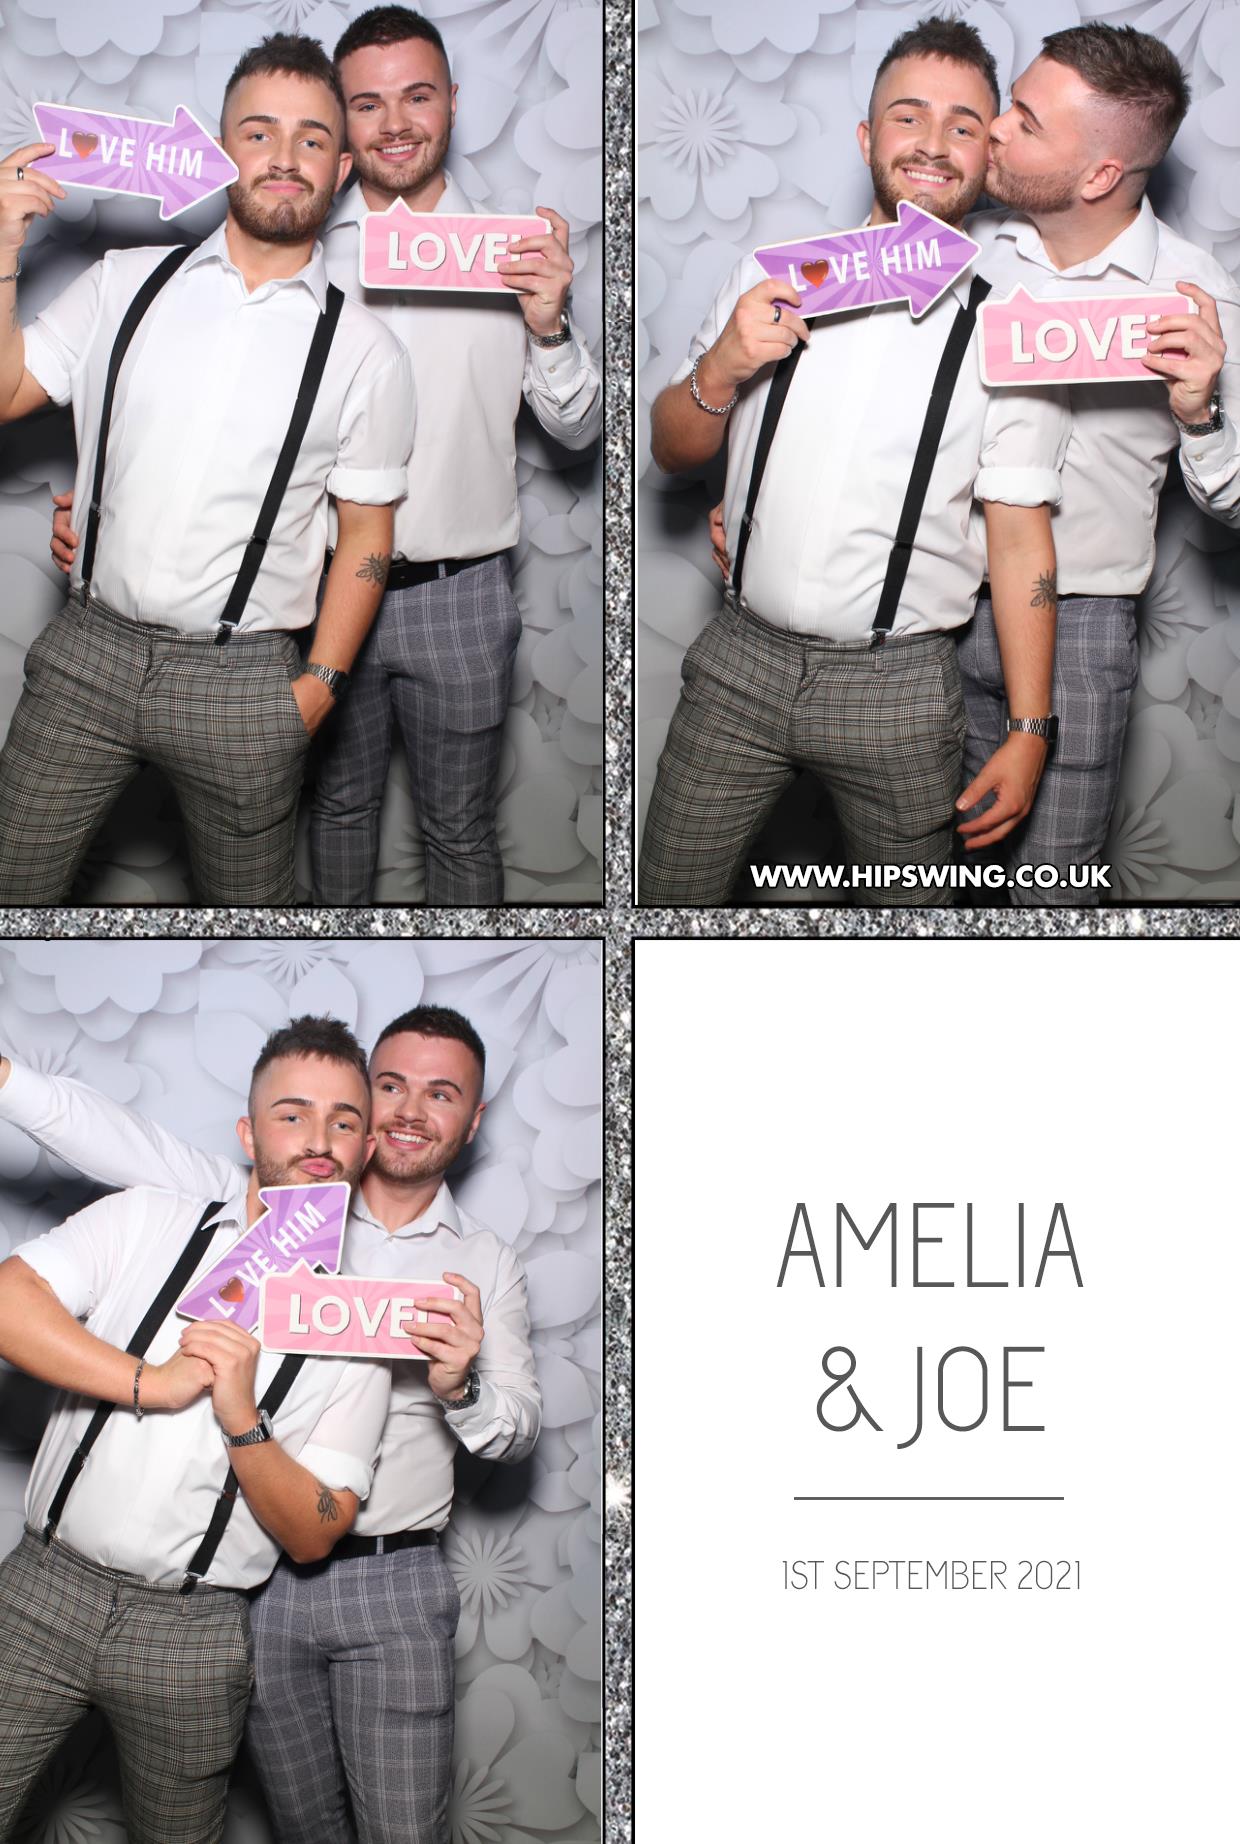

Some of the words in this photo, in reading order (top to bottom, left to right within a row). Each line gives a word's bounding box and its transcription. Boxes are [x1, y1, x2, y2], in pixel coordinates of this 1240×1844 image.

[145, 142, 204, 179] HIM
[880, 238, 942, 276] HIM
[270, 1201, 327, 1258] HIM
